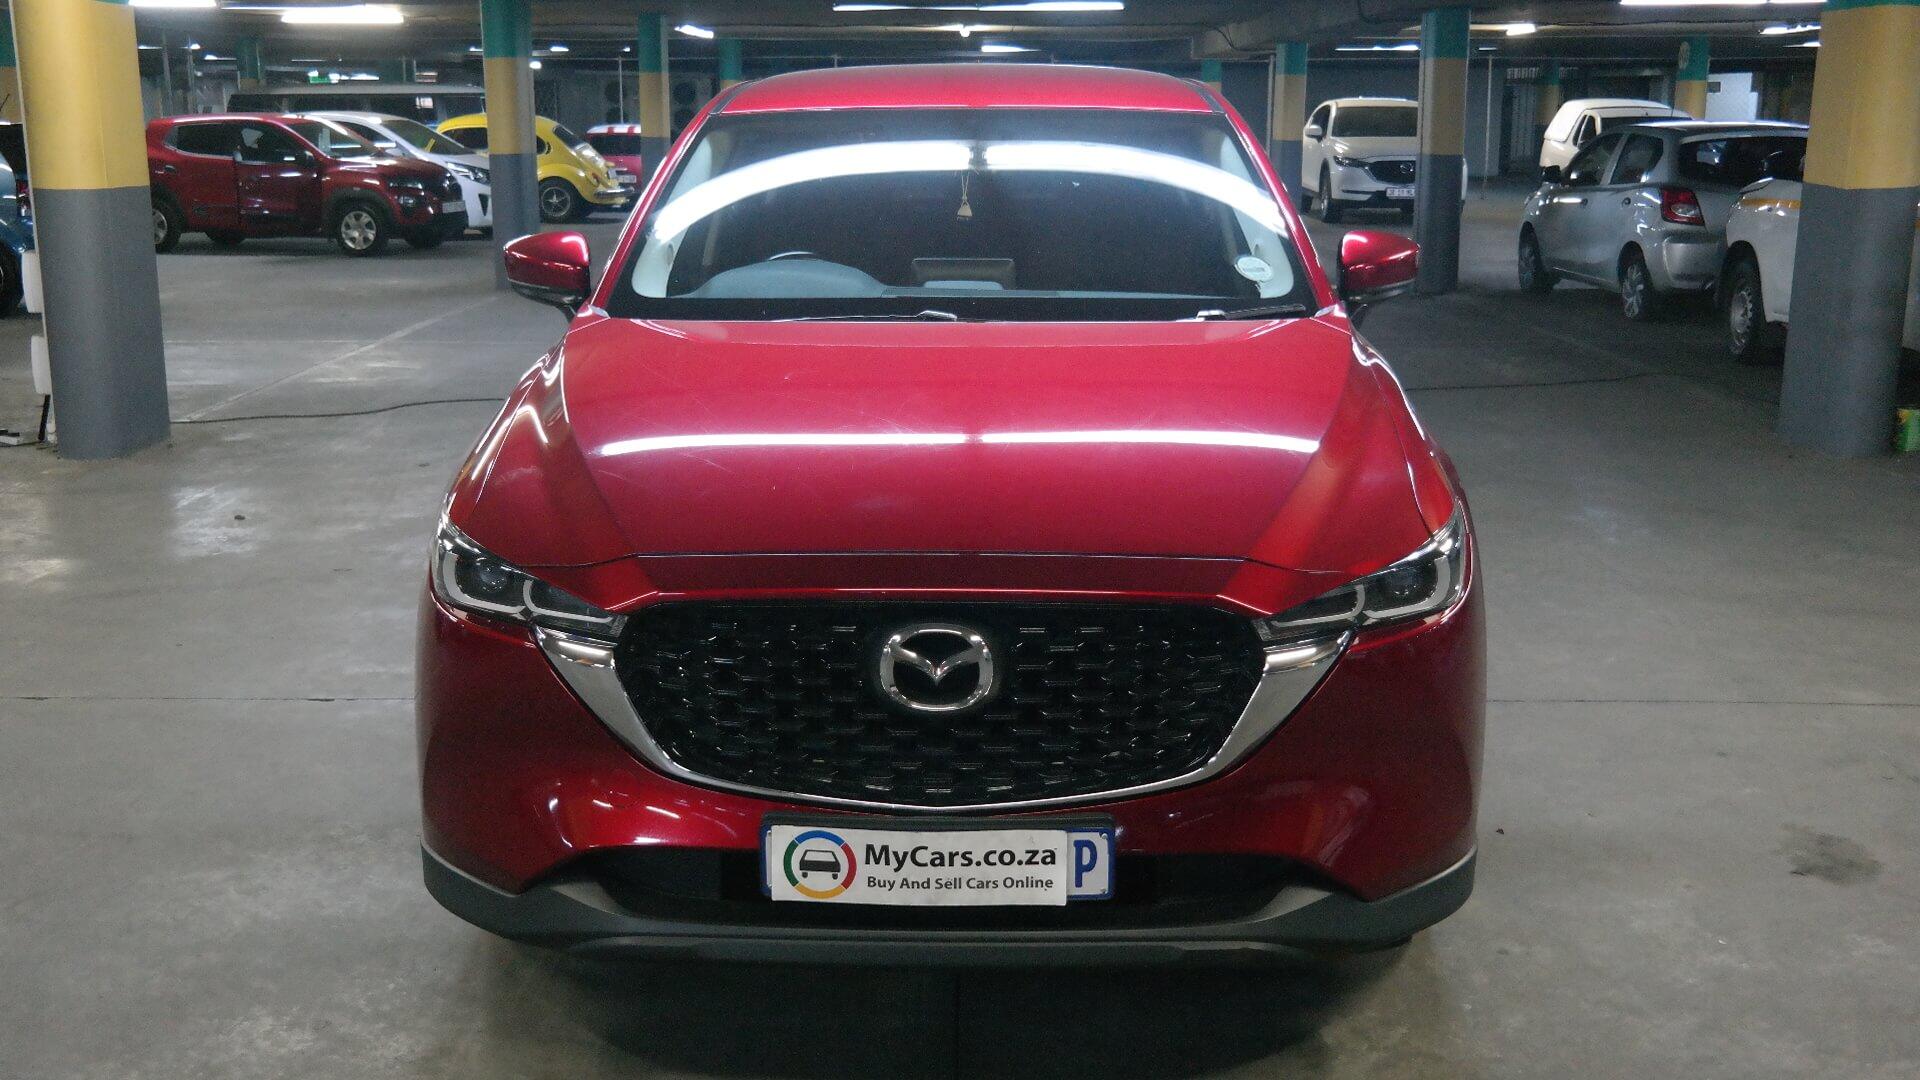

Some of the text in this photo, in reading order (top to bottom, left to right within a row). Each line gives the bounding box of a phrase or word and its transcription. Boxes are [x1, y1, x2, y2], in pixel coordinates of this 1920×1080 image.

[863, 843, 1057, 872] MyCars.co.za
[867, 875, 1055, 892] Buy And Sell Cars Online
